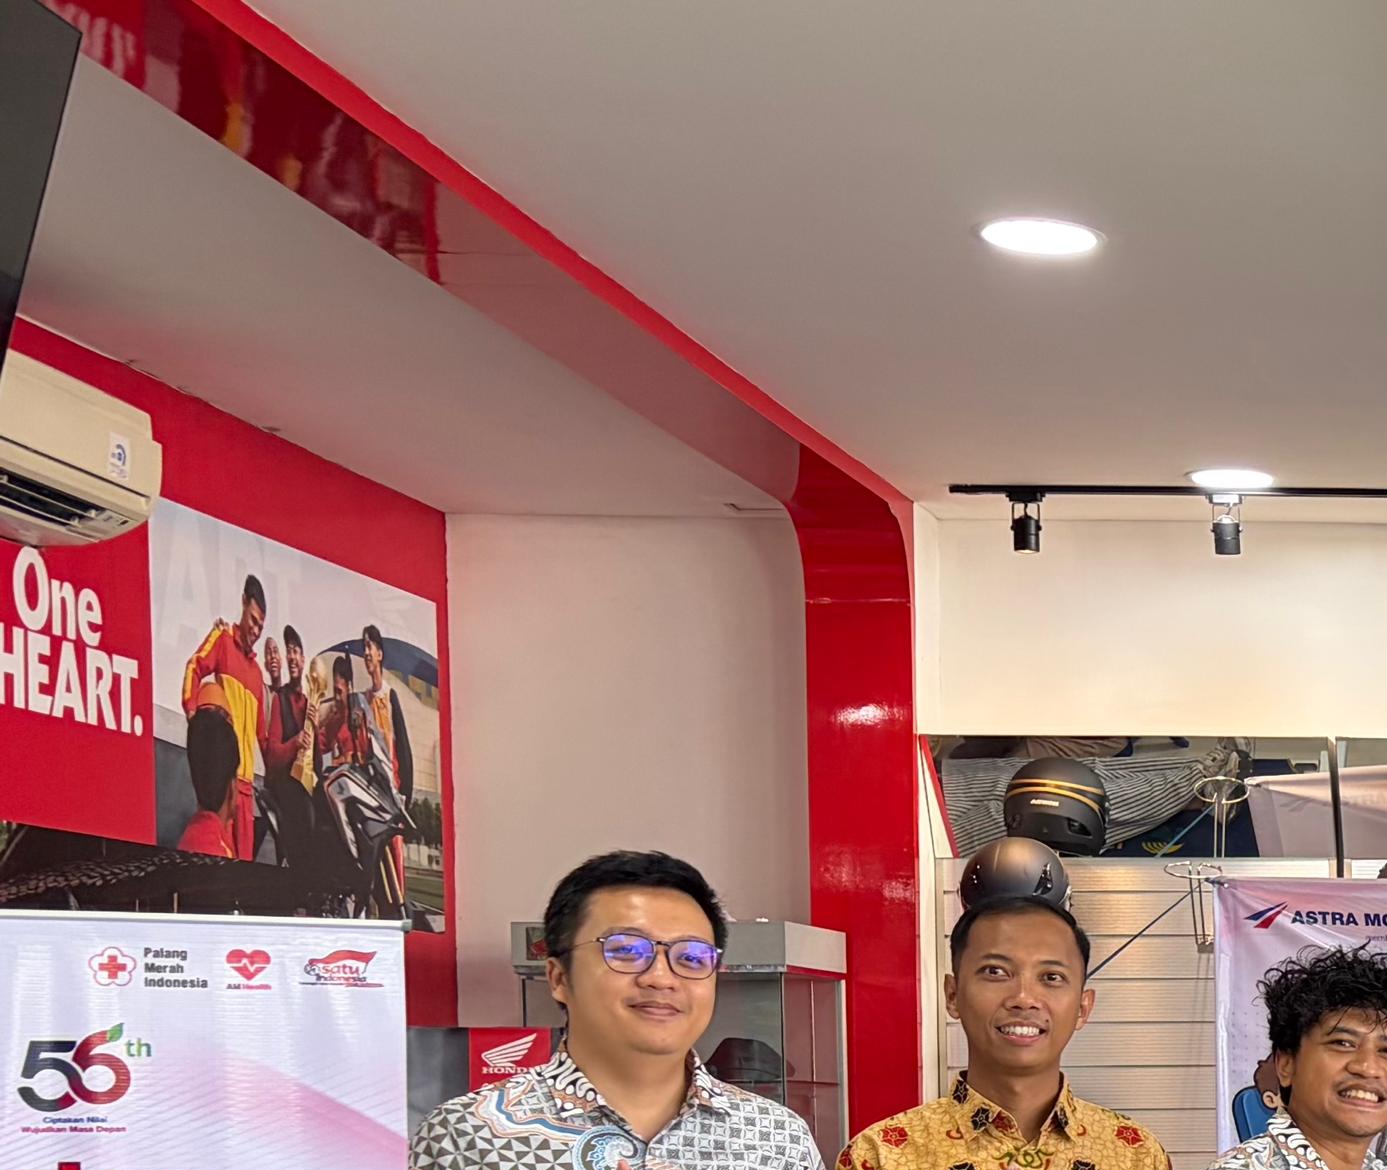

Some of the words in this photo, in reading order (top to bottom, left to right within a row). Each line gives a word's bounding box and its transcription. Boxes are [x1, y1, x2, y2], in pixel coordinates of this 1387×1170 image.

[12, 546, 103, 643] One
[0, 625, 144, 736] HEART.
[1291, 910, 1359, 927] ASTRA
[144, 947, 188, 961] Palang
[144, 963, 184, 973] Merah
[322, 962, 360, 975] satu
[144, 977, 208, 989] Indonesia
